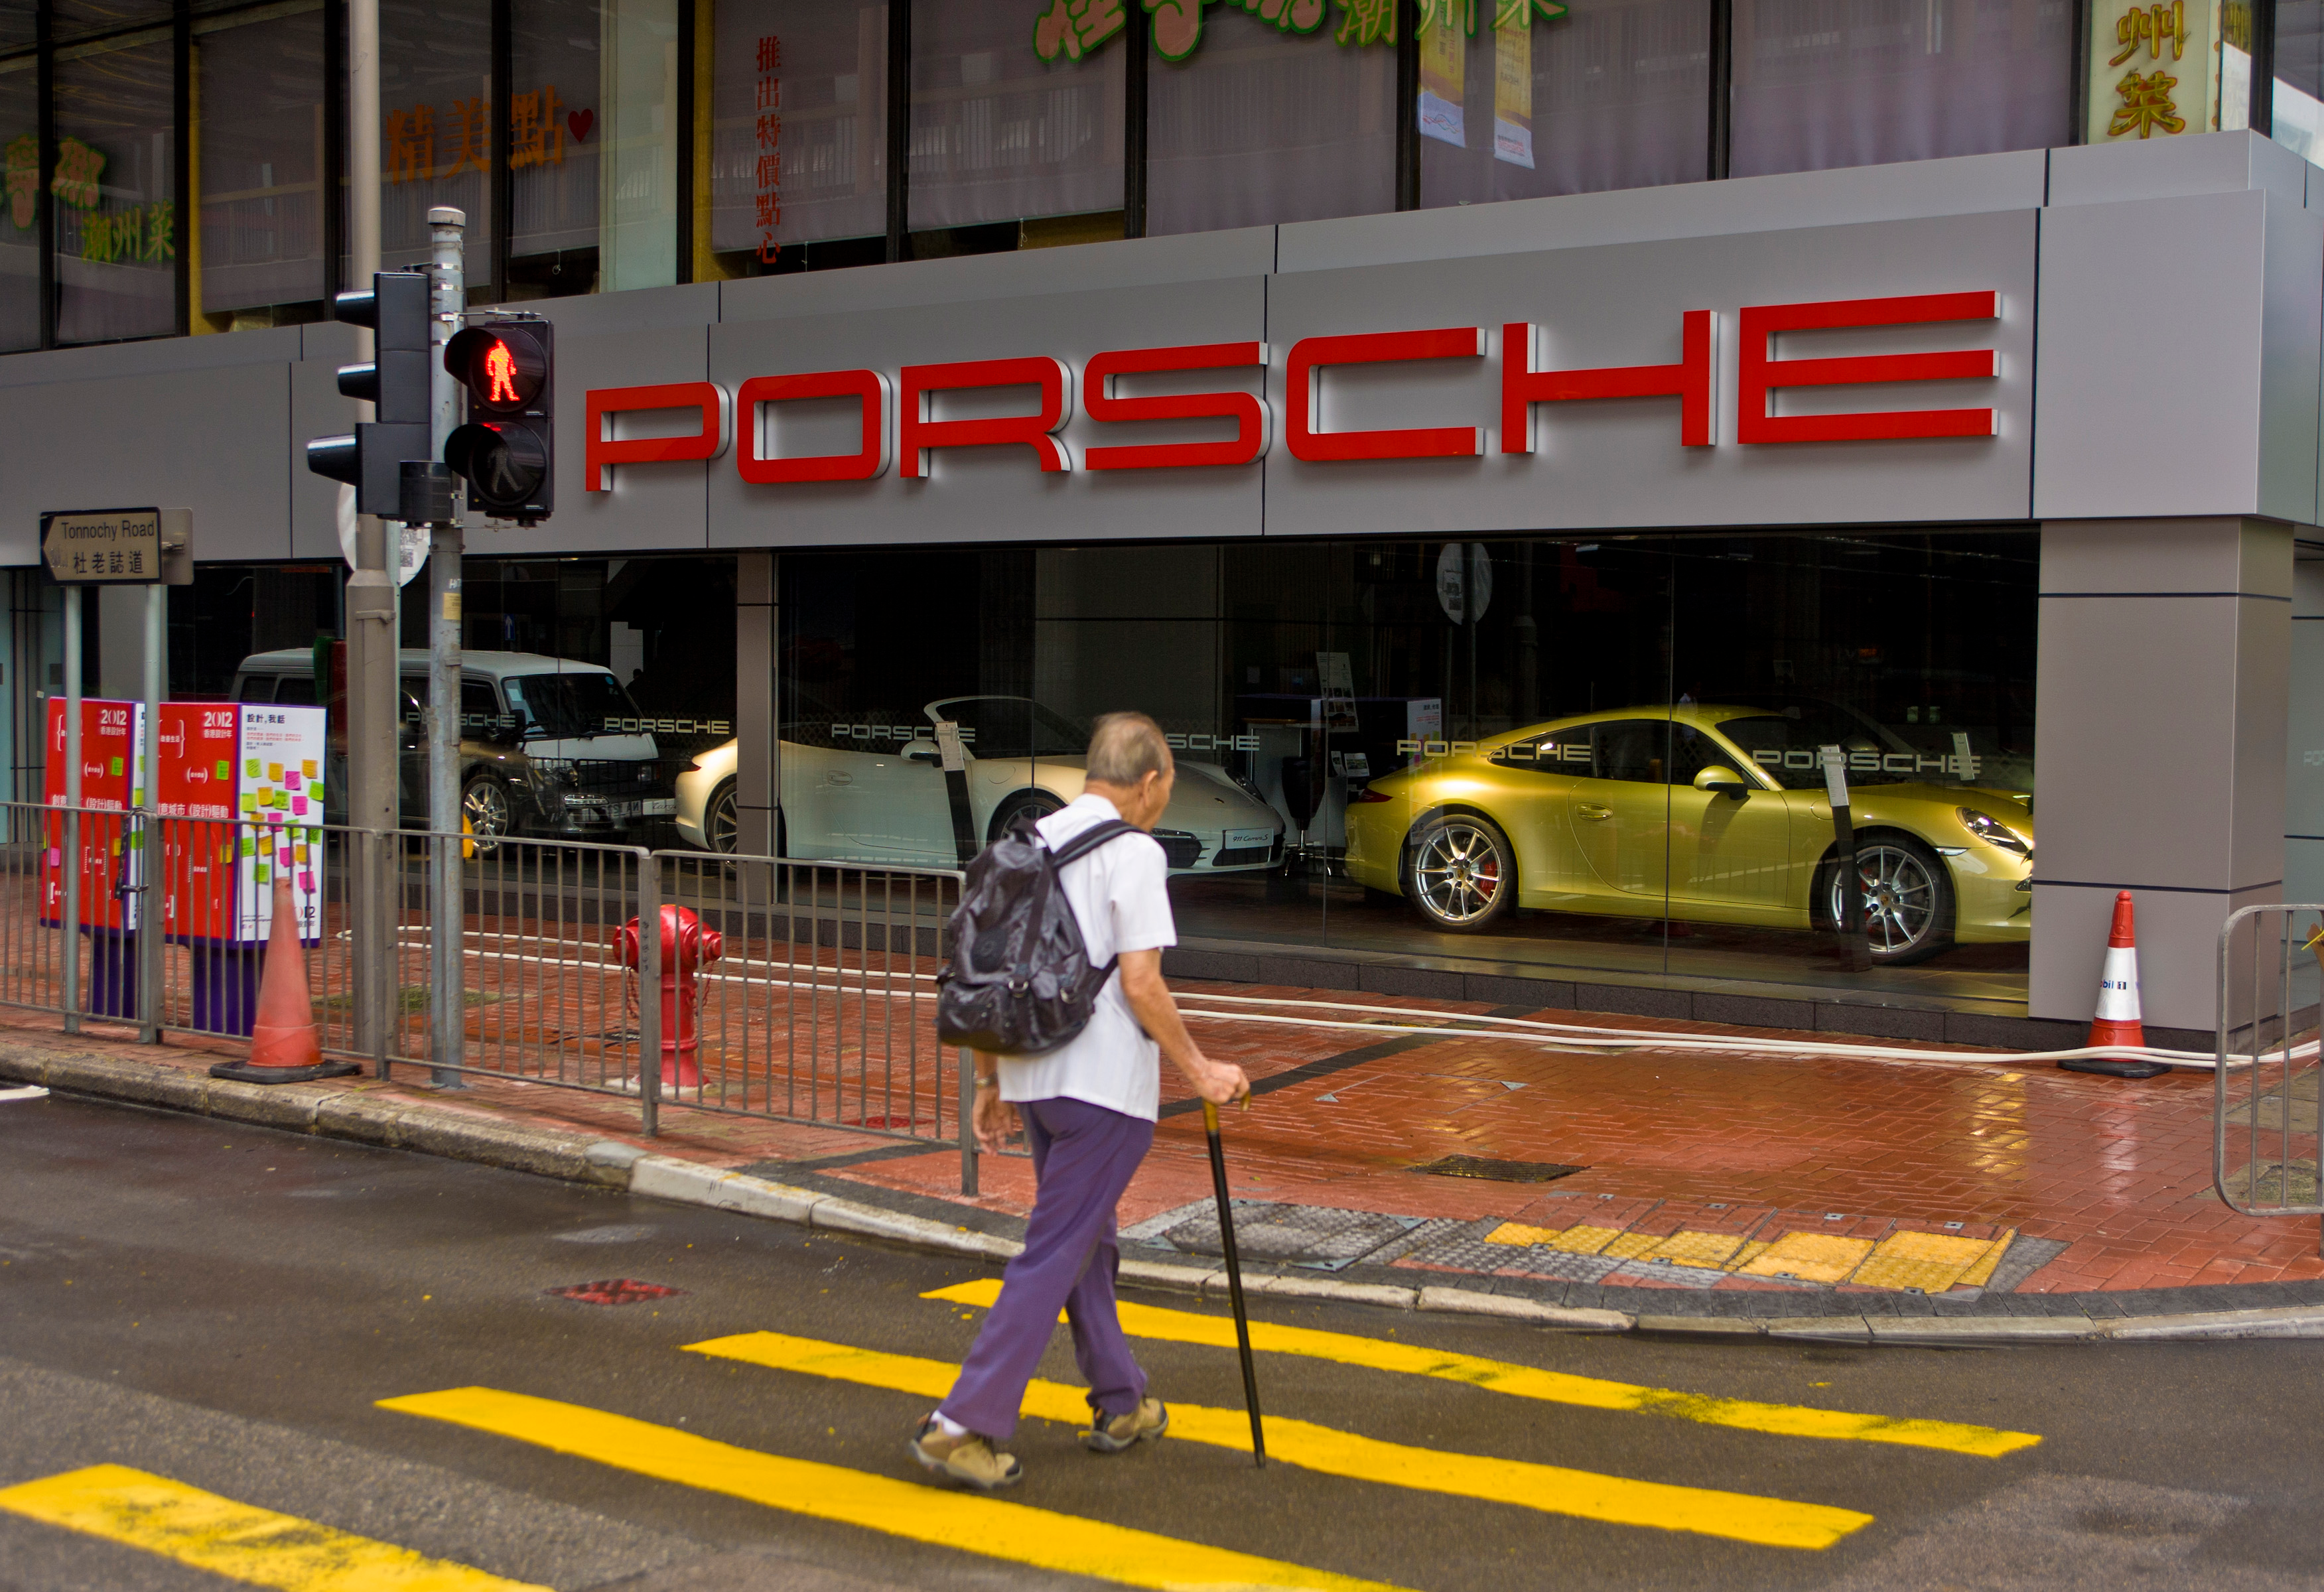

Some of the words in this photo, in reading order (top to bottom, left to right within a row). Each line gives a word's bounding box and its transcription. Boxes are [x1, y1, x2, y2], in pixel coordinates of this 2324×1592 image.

[385, 85, 564, 186] 精美點
[756, 36, 781, 264] 推出特價點心
[80, 198, 175, 264] 潮州菜
[587, 290, 2000, 495] PORSCHE
[61, 521, 118, 541] Tonnochy
[121, 520, 155, 537] Road
[74, 550, 143, 574] 杜老誌道
[604, 718, 730, 734] PORSCHE
[831, 724, 976, 743] PORSCHE
[1165, 733, 1260, 751] SCHE
[1397, 740, 1591, 762] PORSCHE
[1752, 743, 1981, 774] PORSCHE
[2100, 979, 2114, 989] obil
